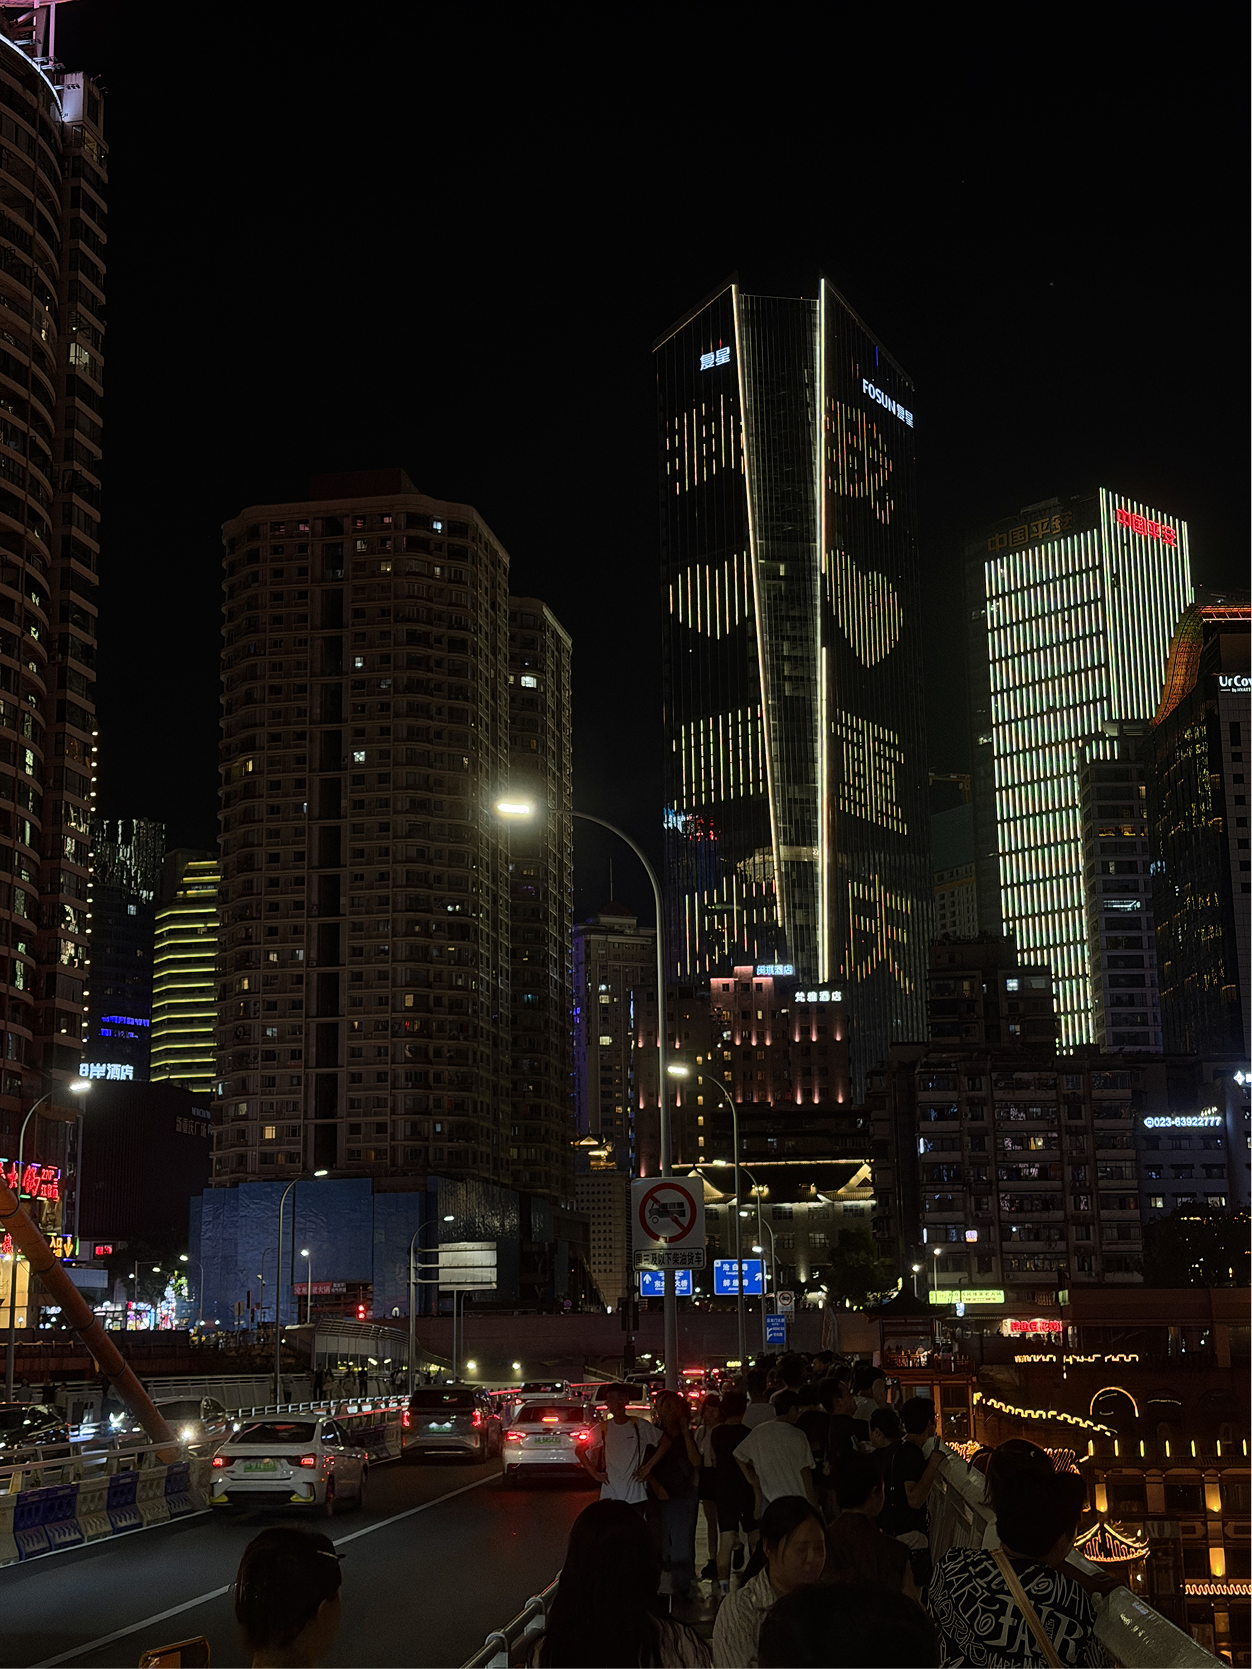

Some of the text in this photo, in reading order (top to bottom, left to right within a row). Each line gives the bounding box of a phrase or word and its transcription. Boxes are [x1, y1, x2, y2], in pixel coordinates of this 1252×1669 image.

[699, 346, 730, 371] 复星
[986, 511, 1073, 552] 中国平安
[1116, 508, 1177, 547] 中国平安
[1154, 1117, 1222, 1127] 023-63922777
[49, 1236, 63, 1249] 入口
[635, 1251, 703, 1266] 国三及以下柴油货车
